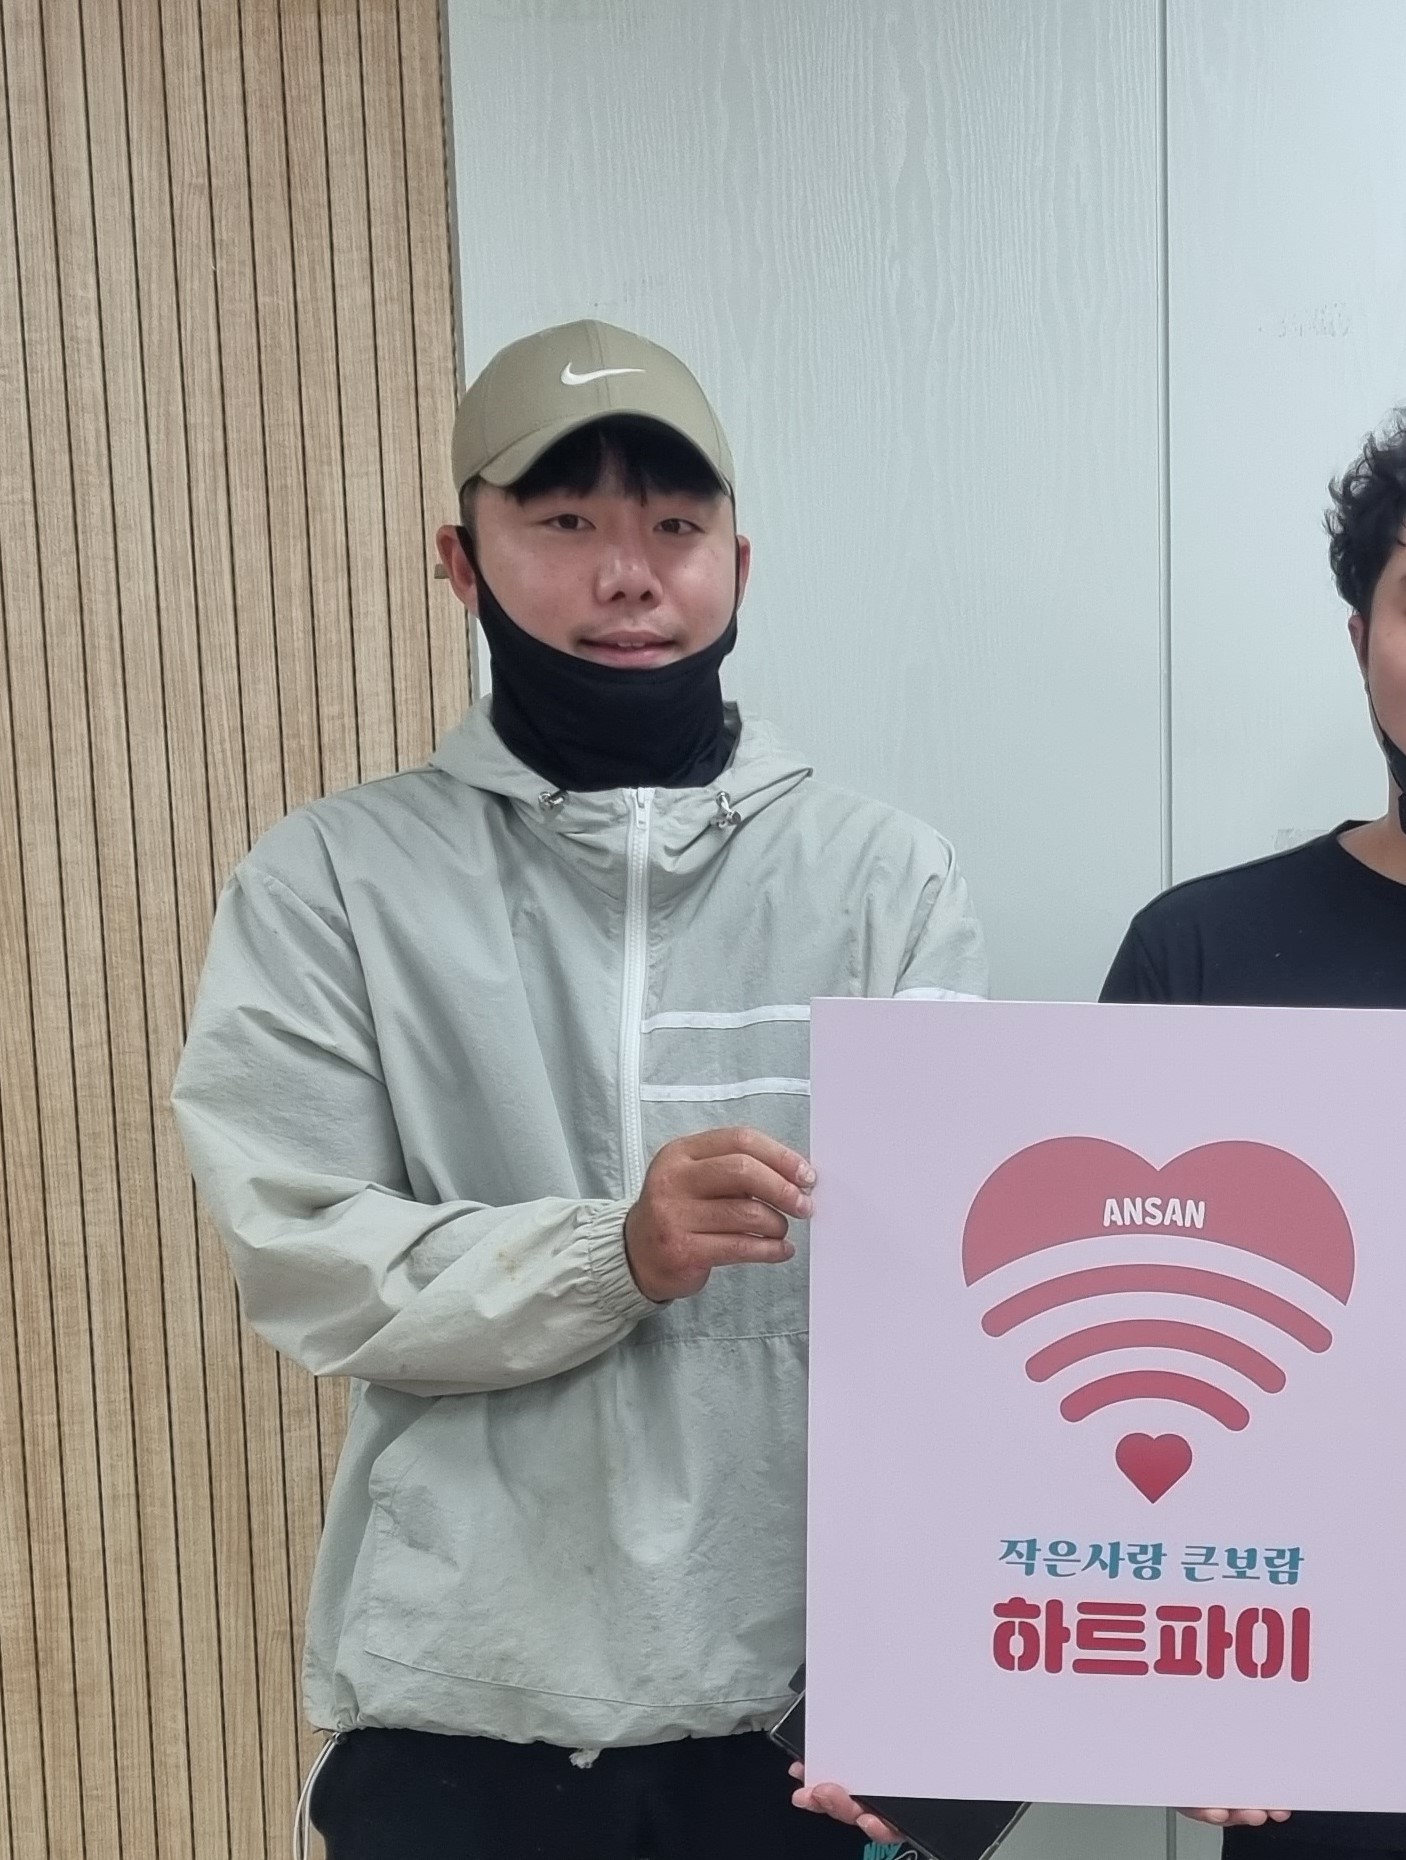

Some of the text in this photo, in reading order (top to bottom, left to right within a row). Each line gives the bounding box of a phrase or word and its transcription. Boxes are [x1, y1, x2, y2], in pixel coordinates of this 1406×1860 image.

[1103, 1197, 1206, 1229] ANSAN
[998, 1538, 1305, 1585] 작은사랑 큰보람
[992, 1597, 1311, 1682] 하트파이
